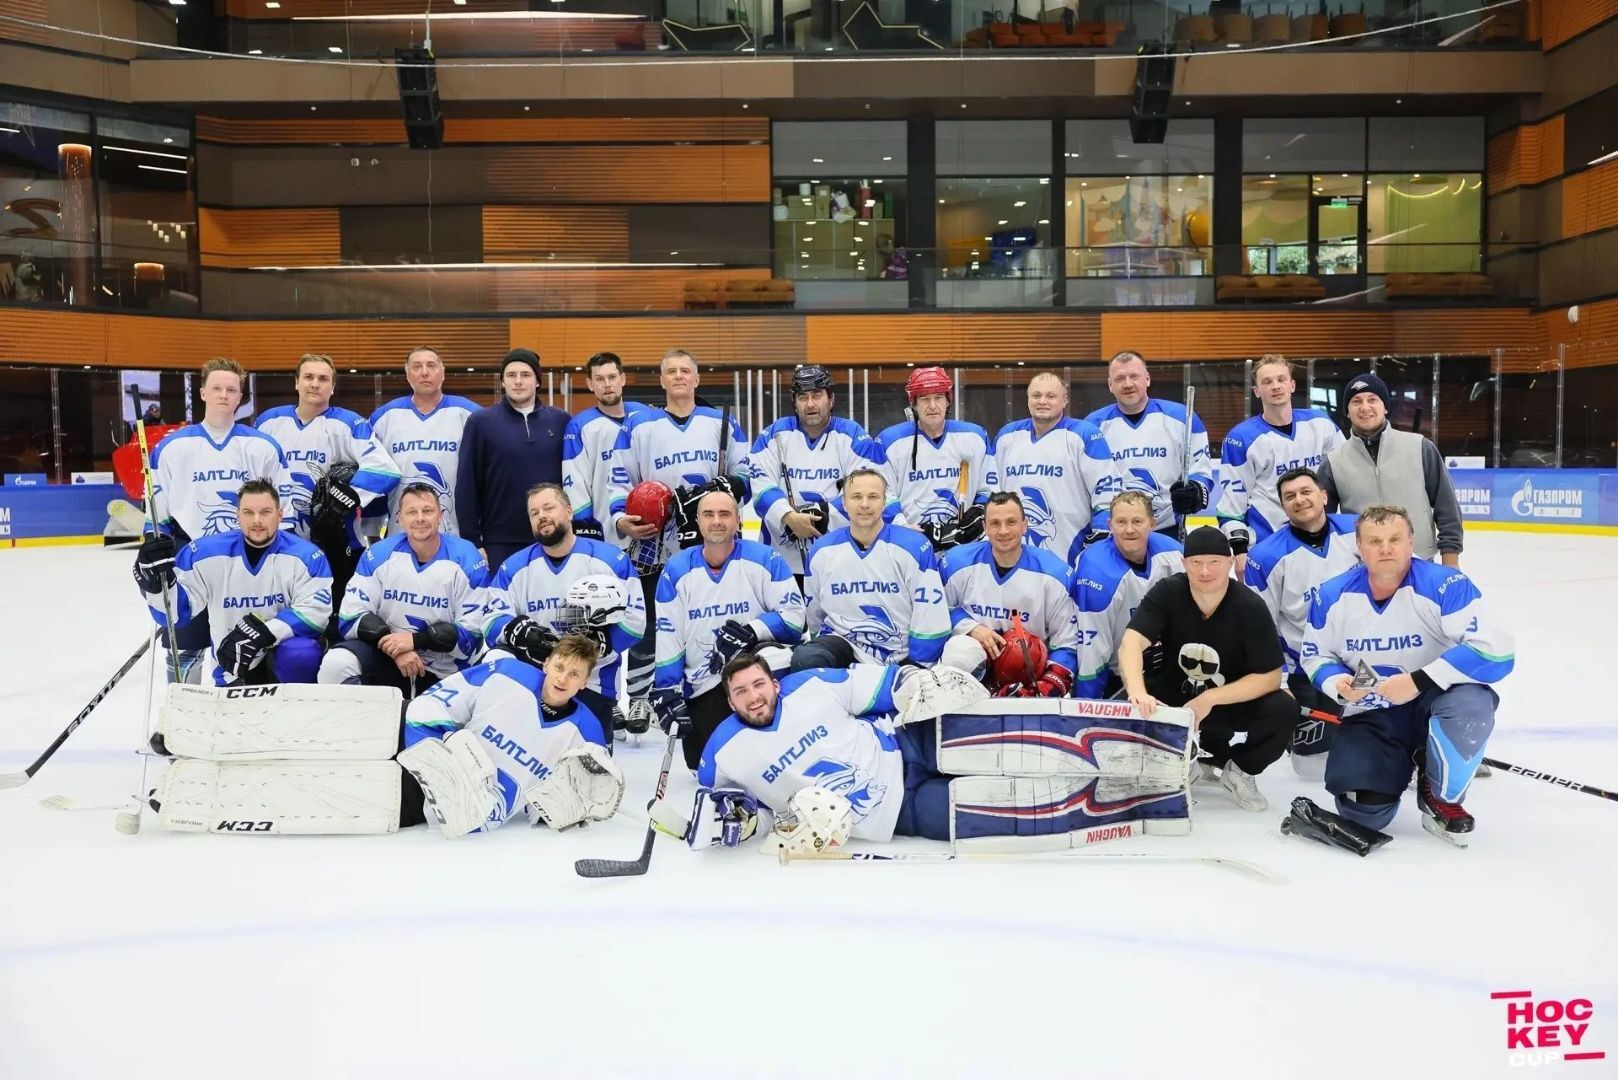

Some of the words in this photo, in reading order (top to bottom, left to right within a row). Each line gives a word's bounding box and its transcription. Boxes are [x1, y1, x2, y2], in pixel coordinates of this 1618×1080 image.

[909, 467, 961, 482] БАЛТЛИ
[1456, 489, 1490, 503] ЗПРОМ
[1534, 490, 1582, 505] ГАЗПРОМ
[831, 581, 900, 595] БАЛТЛИЗ
[223, 593, 285, 608] БАЛТЛИЗ
[383, 589, 449, 608] БАЛТЛИЗ
[970, 604, 1030, 622] БАЛТЛЗ
[1346, 634, 1423, 651] БАЛТЛИЗ
[226, 686, 278, 699] CCM
[1078, 702, 1131, 717] VAUGHN
[481, 725, 553, 780] БАЛТЛИ
[761, 725, 829, 784] БАЛТЛИЗ
[217, 820, 274, 832] CCM
[1086, 825, 1132, 843] VAUGHN
